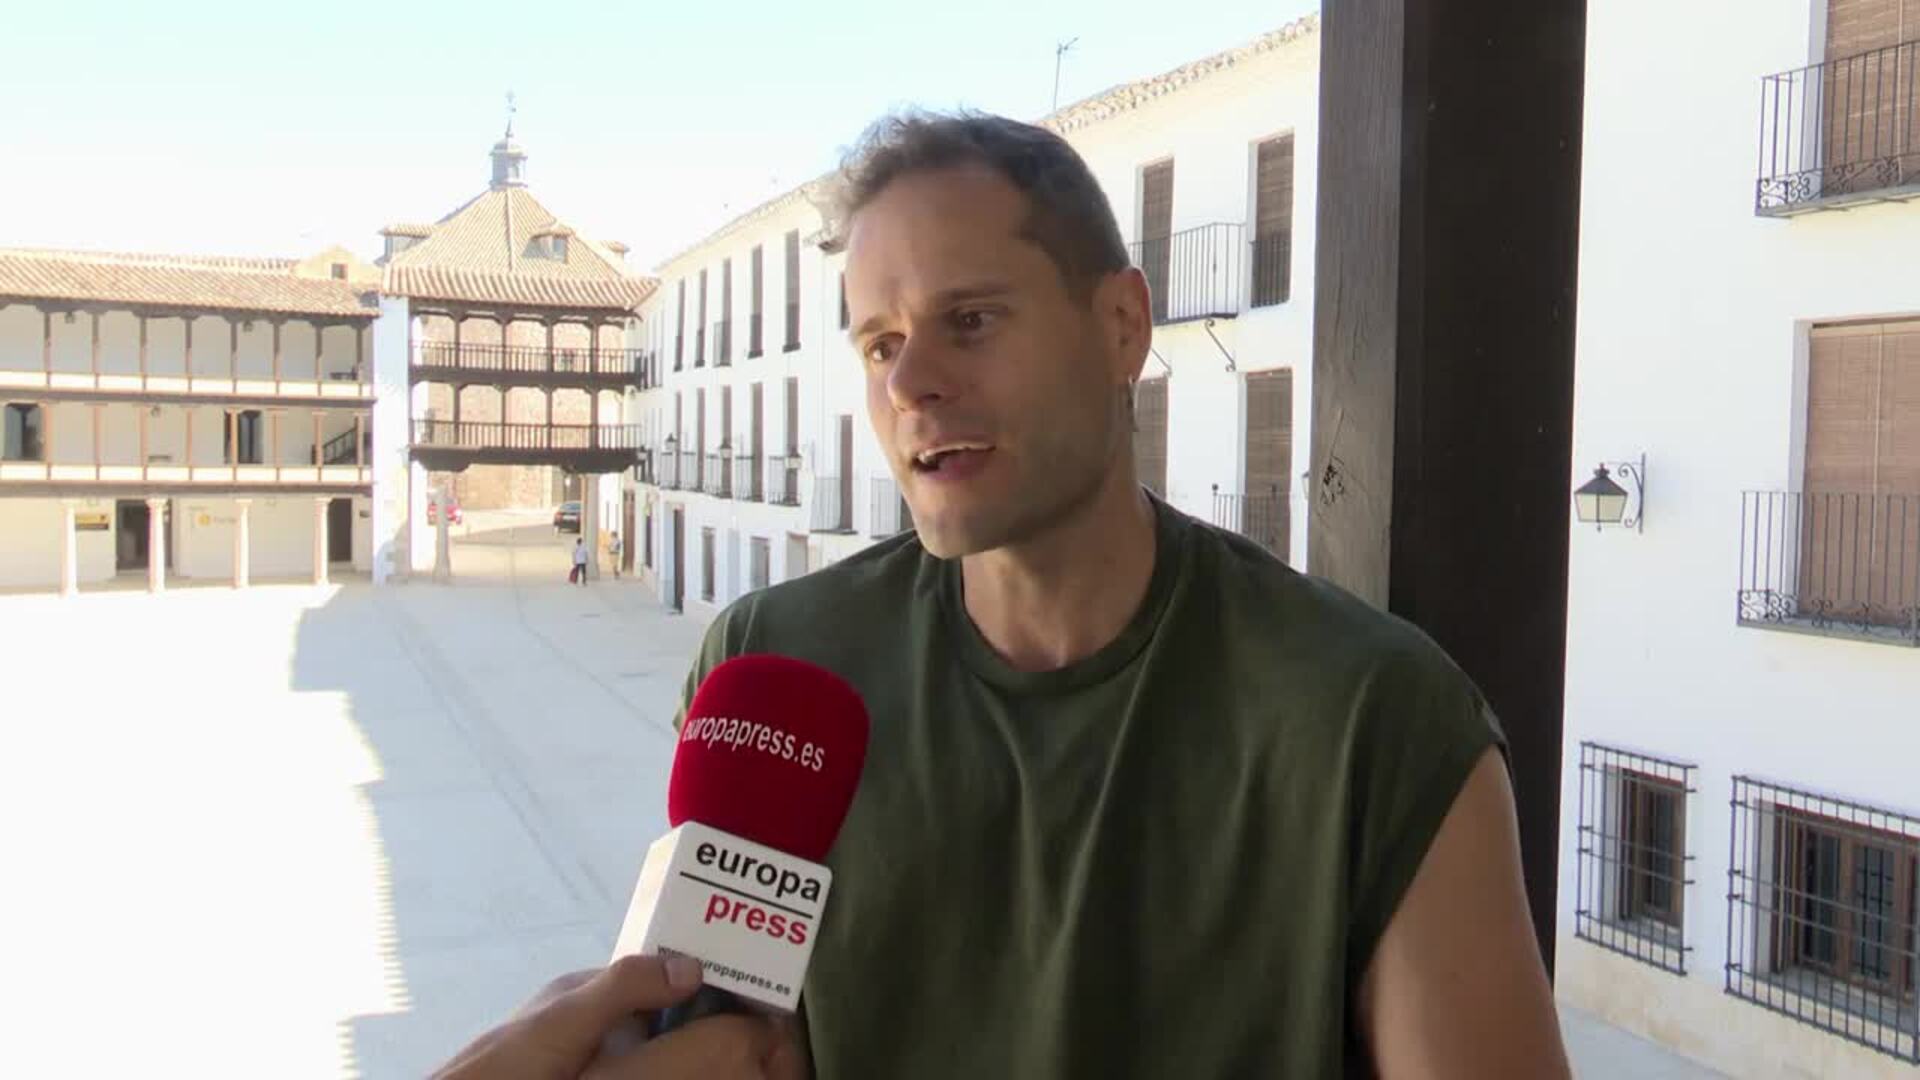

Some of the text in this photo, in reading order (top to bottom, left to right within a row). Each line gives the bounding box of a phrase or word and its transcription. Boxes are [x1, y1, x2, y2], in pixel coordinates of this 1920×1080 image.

[682, 716, 825, 772] europapress.es
[696, 842, 821, 903] europa
[704, 893, 808, 945] press
